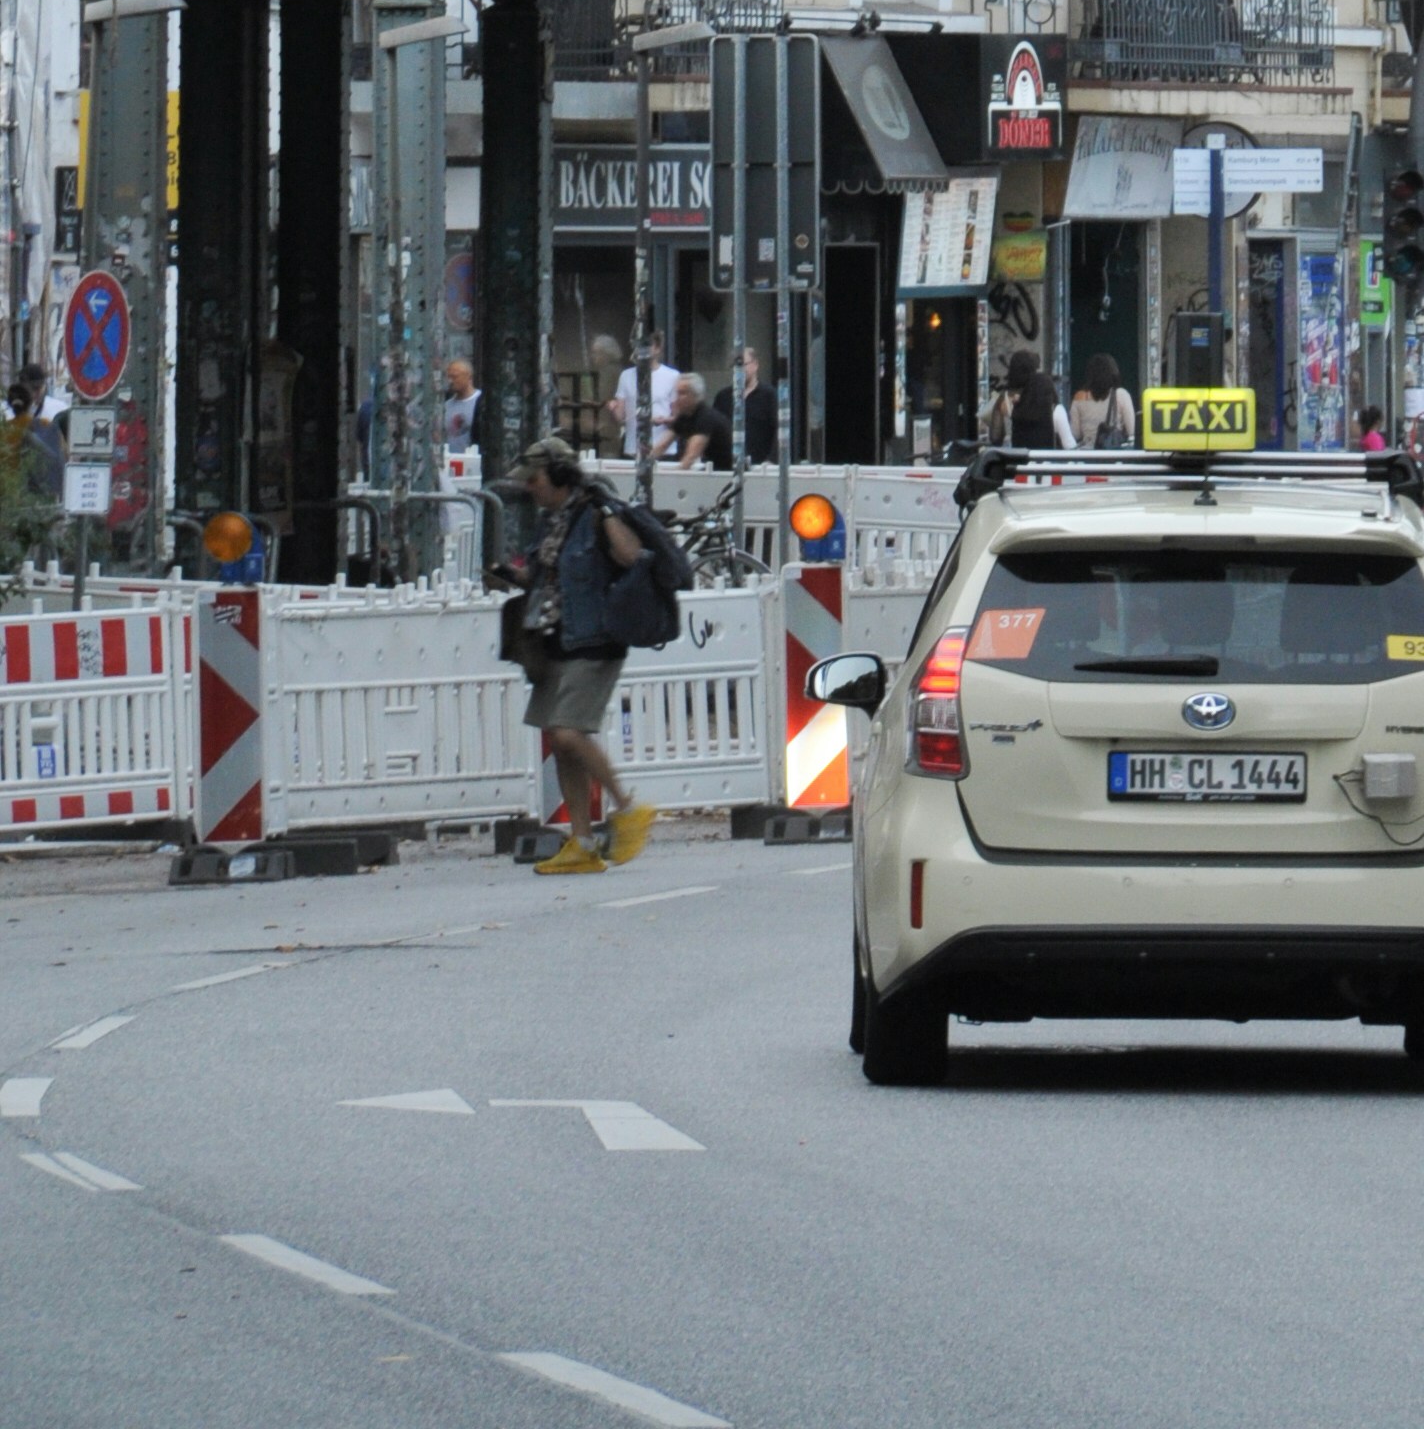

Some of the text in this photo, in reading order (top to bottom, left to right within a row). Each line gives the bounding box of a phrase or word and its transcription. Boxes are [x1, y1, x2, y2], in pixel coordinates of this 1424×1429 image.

[1154, 402, 1244, 431] TAXI
[998, 613, 1036, 629] 377
[1129, 758, 1301, 790] HH CL 1444
